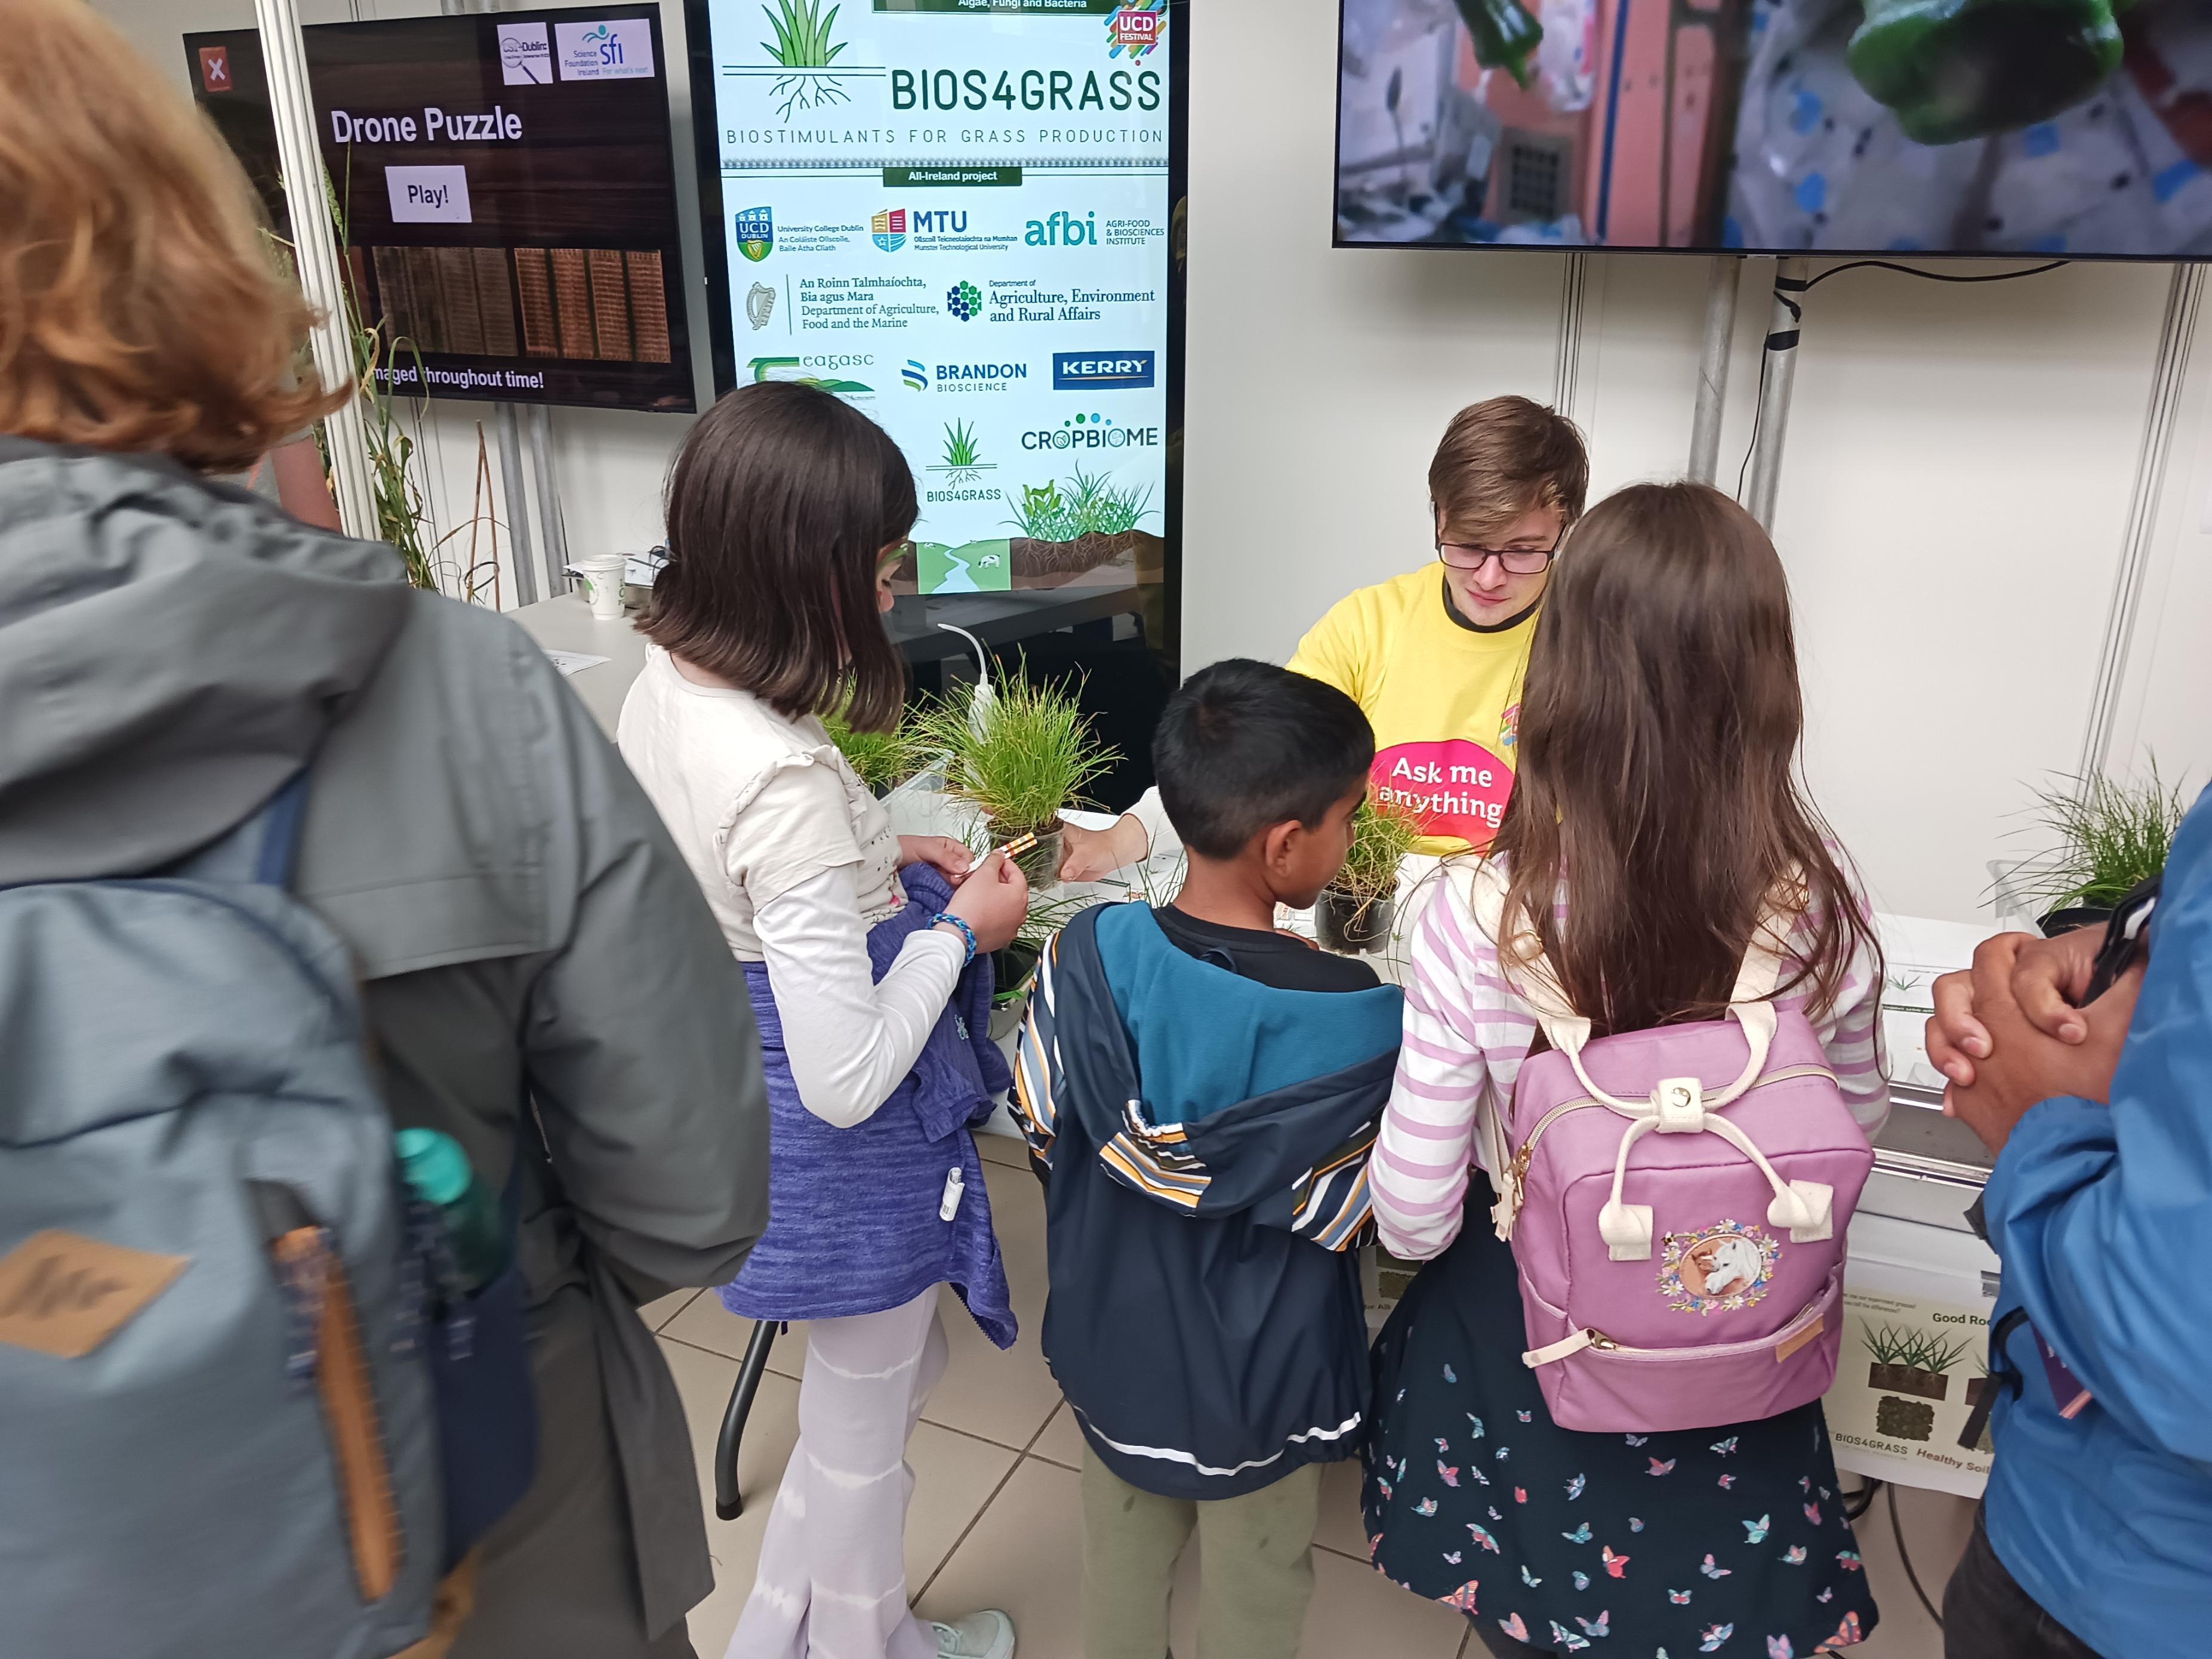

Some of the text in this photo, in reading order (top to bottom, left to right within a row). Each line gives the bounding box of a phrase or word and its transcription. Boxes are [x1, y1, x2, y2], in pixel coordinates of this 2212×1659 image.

[1120, 16, 1154, 32] UCD
[892, 69, 1162, 112] BIOS4GRASS
[331, 106, 522, 143] Drone Puzzle
[728, 129, 1163, 144] BIOSTIMULANTS FOR GRASS PRODUCTION
[908, 171, 998, 182] All-Ireland project
[408, 184, 449, 208] Play!
[740, 223, 769, 233] UCD
[914, 210, 968, 233] MTU
[1025, 211, 1098, 246] afbi
[1114, 228, 1164, 236] BIOSCIENCES
[800, 276, 927, 289] An Roinn Talmhaíochta,
[800, 291, 874, 304] Bia agus Mara
[989, 288, 1156, 309] Agriculture, Environment
[802, 304, 940, 317] Department of Agriculture,
[990, 306, 1101, 322] and Rural Affairs
[803, 317, 908, 329] Food and the Marine
[936, 363, 1027, 380] BRANDON
[1062, 359, 1148, 375] KERRY
[505, 371, 544, 388] time!
[936, 383, 1008, 392] BIOSCIENCE
[1021, 427, 1159, 450] CROPBIOME
[927, 489, 1002, 502] BIOS4GRASS
[1392, 757, 1493, 788] Ask me
[1379, 785, 1503, 828] anything
[1933, 1312, 1965, 1324] Good
[1835, 1433, 1909, 1455] BIOS4GRASS
[1917, 1448, 1963, 1469] Healthy
